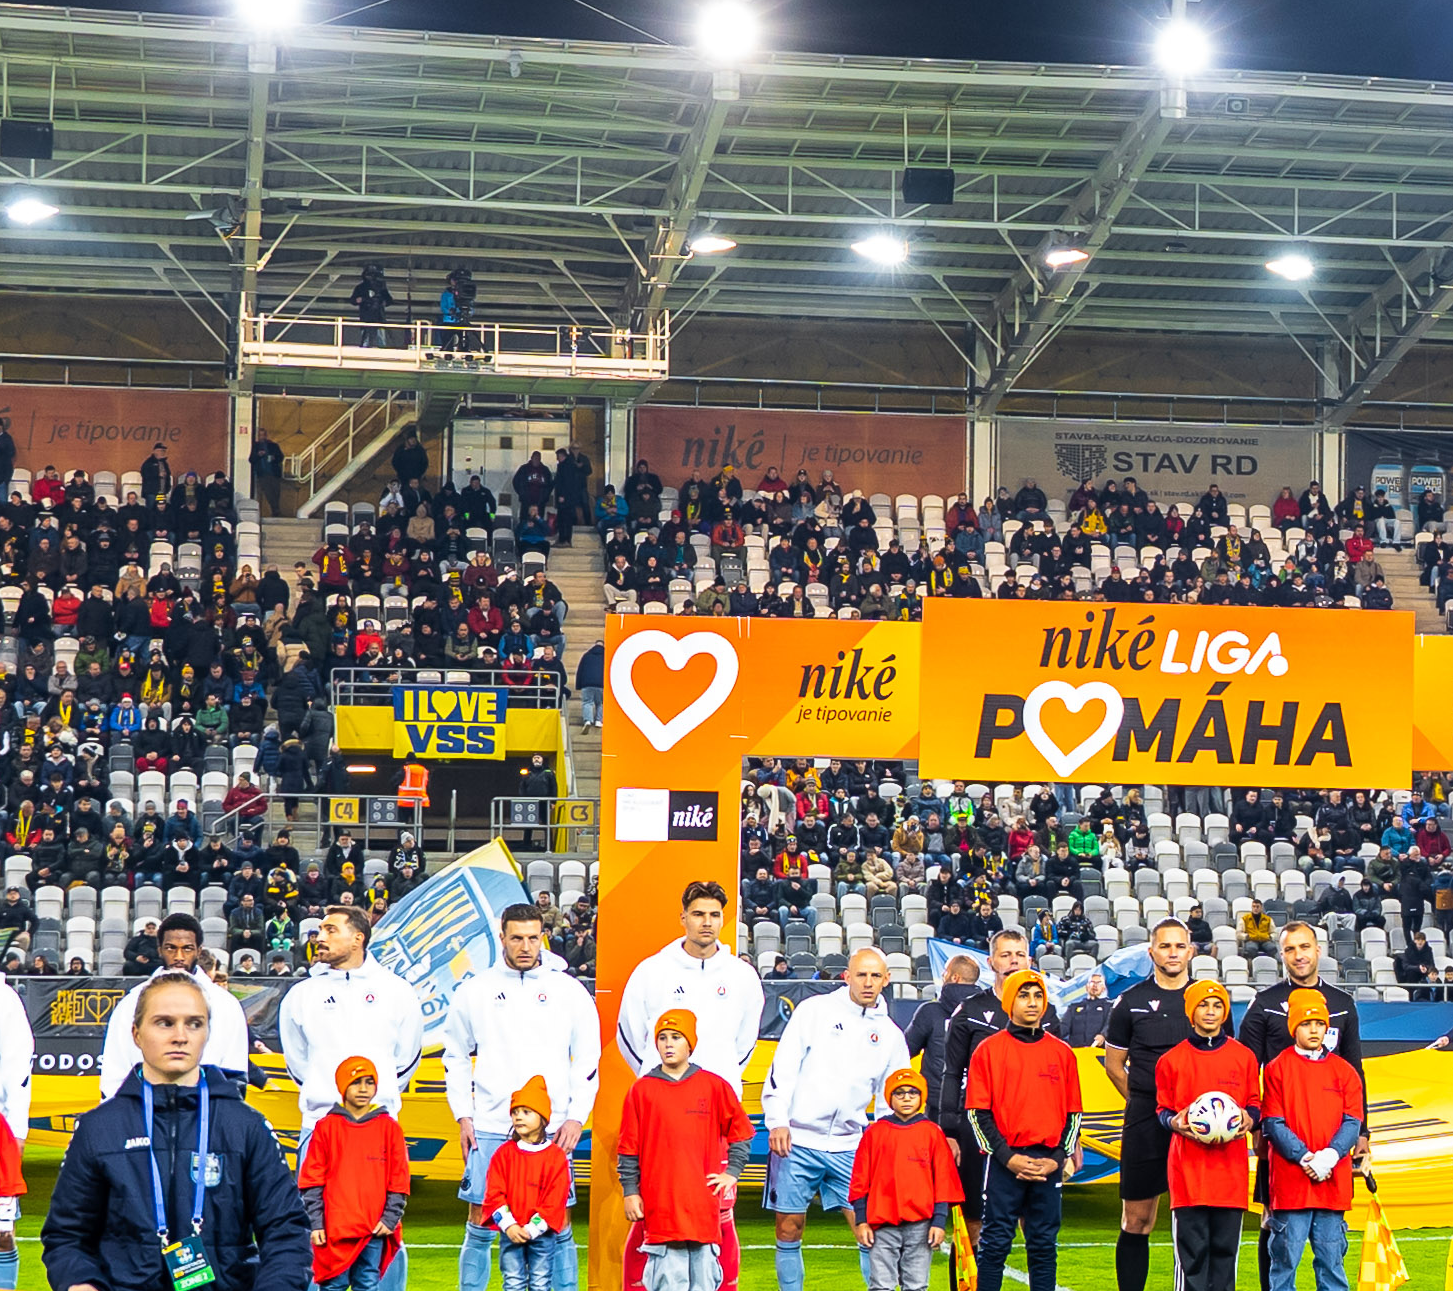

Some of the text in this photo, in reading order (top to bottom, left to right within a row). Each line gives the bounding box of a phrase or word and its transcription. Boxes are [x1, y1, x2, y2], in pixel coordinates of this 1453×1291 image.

[49, 420, 71, 443] je
[76, 420, 182, 444] tipovanie
[1055, 431, 1259, 446] STAVBA-REALIZÁCIA-DOZOROVANIE
[681, 425, 924, 470] niké je tipovanie
[1112, 451, 1259, 476] STAV RD
[1411, 477, 1442, 486] POWER
[1039, 607, 1289, 677] niké LIGA
[798, 648, 897, 701] niké
[404, 691, 414, 721] I
[795, 704, 893, 724] je tipovanie
[406, 724, 496, 754] VSS
[333, 802, 354, 821] C4
[570, 804, 589, 822] C3
[672, 804, 714, 827] niké
[124, 1136, 151, 1150] JAKO
